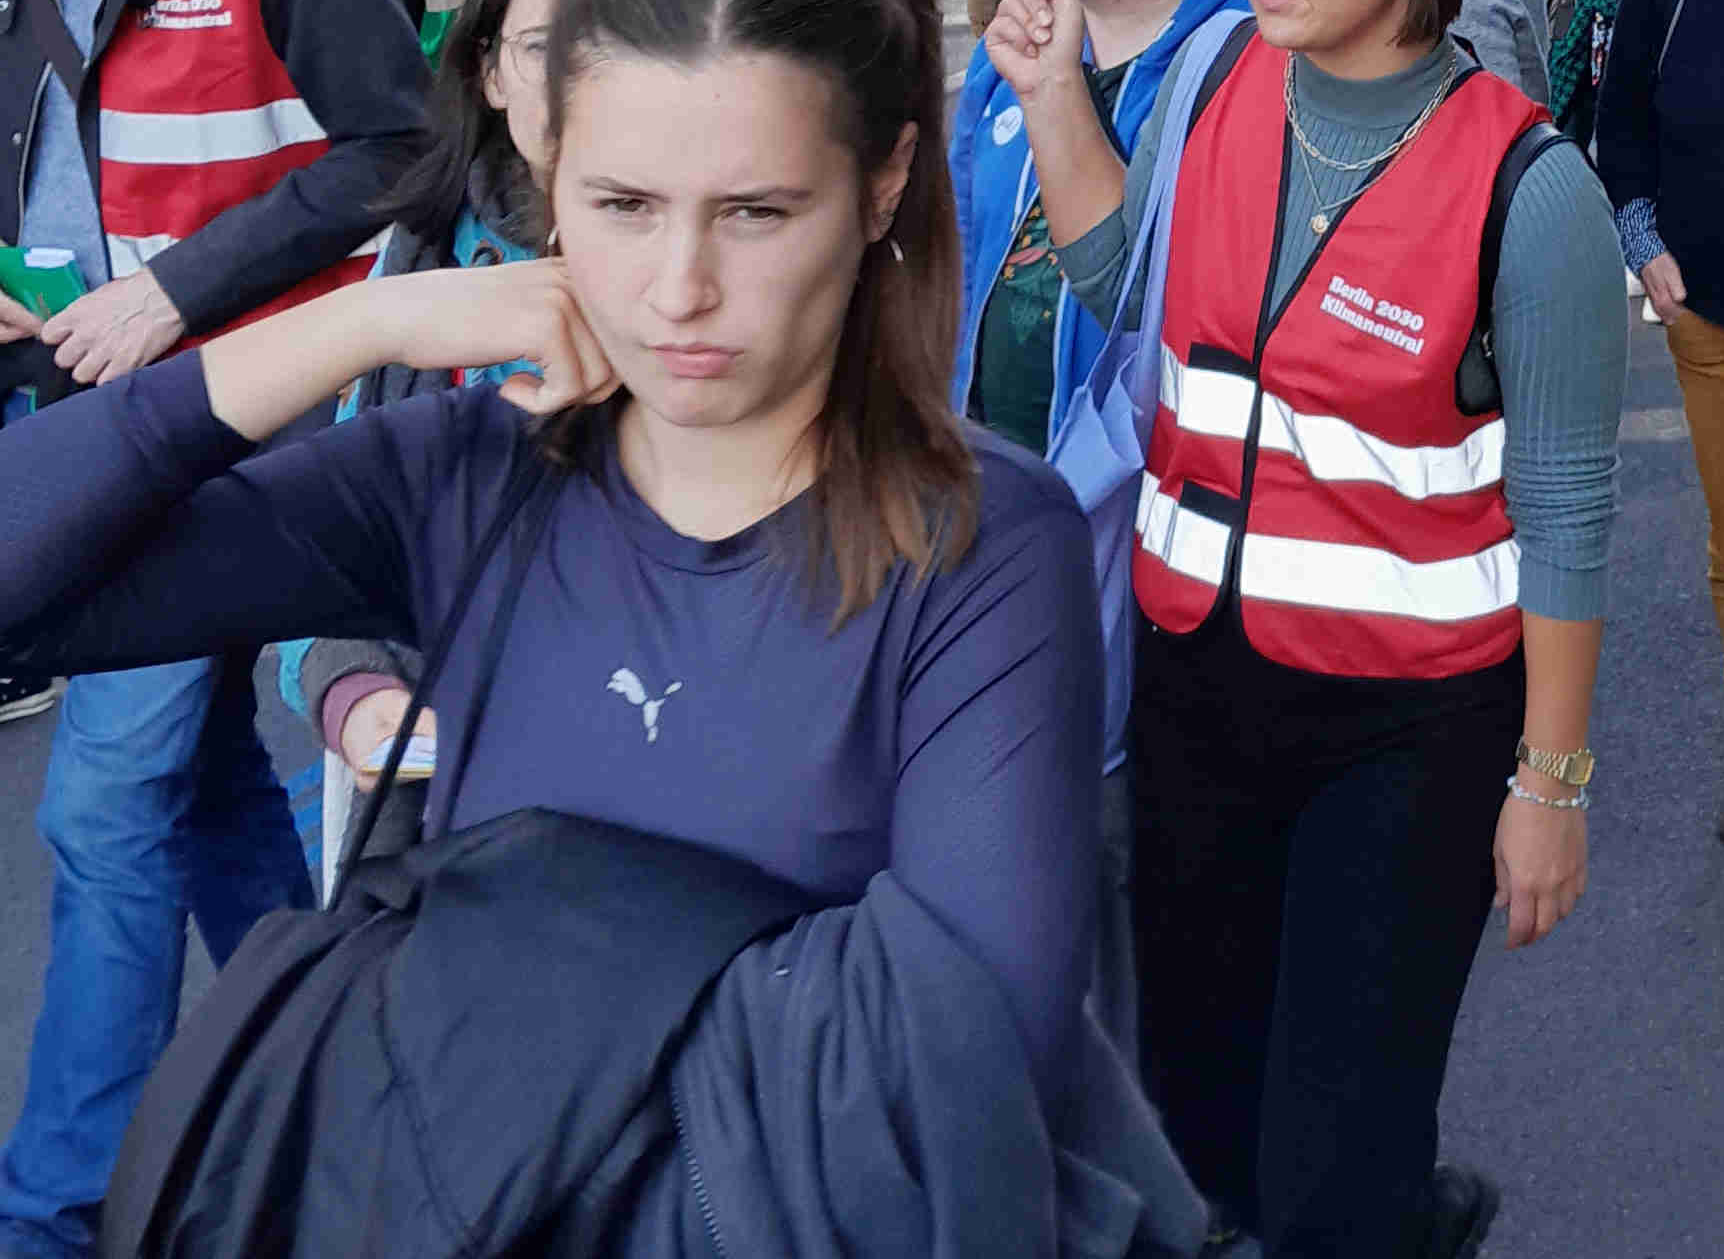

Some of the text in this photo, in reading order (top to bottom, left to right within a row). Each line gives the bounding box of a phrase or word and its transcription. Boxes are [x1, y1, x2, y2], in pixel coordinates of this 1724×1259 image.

[1319, 293, 1425, 357] Klimaneutral
[1327, 275, 1425, 332] Berlin 2030
